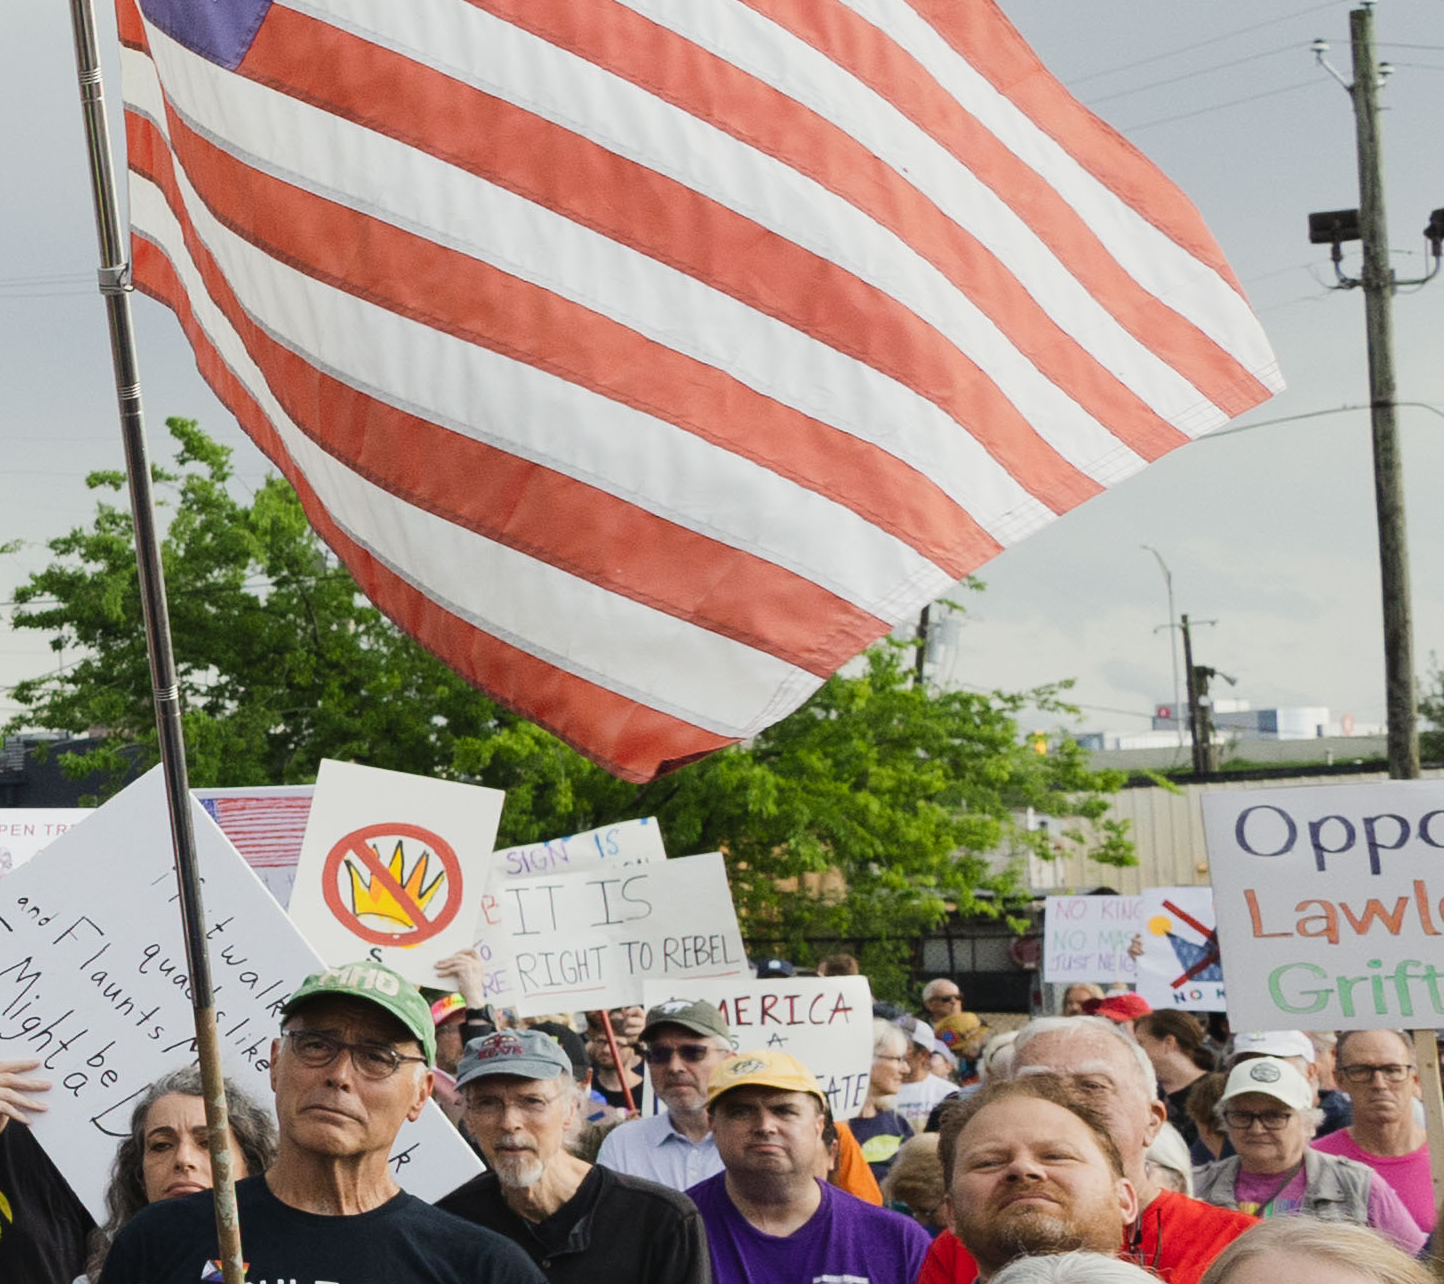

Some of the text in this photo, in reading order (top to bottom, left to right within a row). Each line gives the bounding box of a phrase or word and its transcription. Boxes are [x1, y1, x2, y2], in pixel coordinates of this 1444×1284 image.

[45, 824, 76, 836] TR
[506, 828, 620, 875] SIGN IS
[505, 885, 564, 936] IT
[585, 875, 652, 927] IS
[1055, 900, 1086, 920] NO
[1244, 879, 1444, 945] Lawl
[17, 896, 166, 1041] and Flaunts
[516, 934, 740, 993] RIGHT TO REBEL
[719, 993, 853, 1026] MERICA
[1173, 989, 1202, 1004] NO
[62, 1071, 89, 1098] a
[86, 1040, 119, 1089] be
